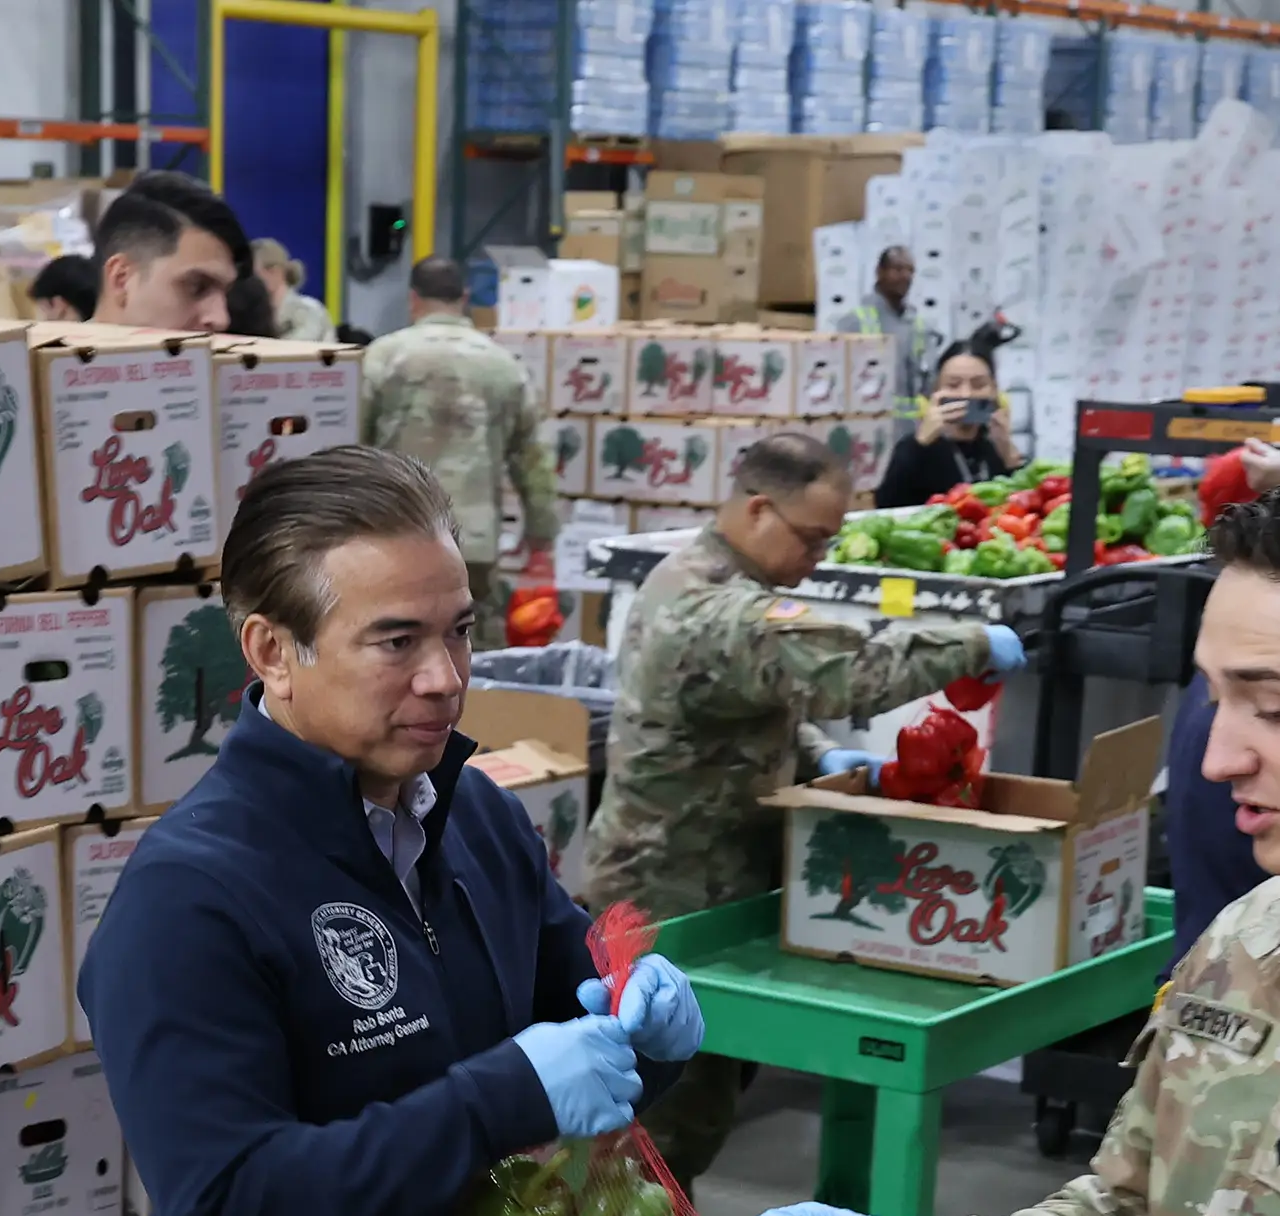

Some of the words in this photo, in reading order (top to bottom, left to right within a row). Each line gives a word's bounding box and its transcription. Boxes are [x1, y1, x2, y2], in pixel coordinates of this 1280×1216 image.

[81, 434, 154, 502] Live
[109, 475, 177, 548] Oak
[18, 725, 90, 798] Oak
[876, 841, 978, 899] Live
[907, 898, 1009, 952] Oak
[326, 1042, 348, 1058] CA
[349, 1029, 396, 1054] Attorney
[394, 1013, 431, 1038] General
[353, 1014, 377, 1035] Rob
[376, 1005, 407, 1027] Bonta
